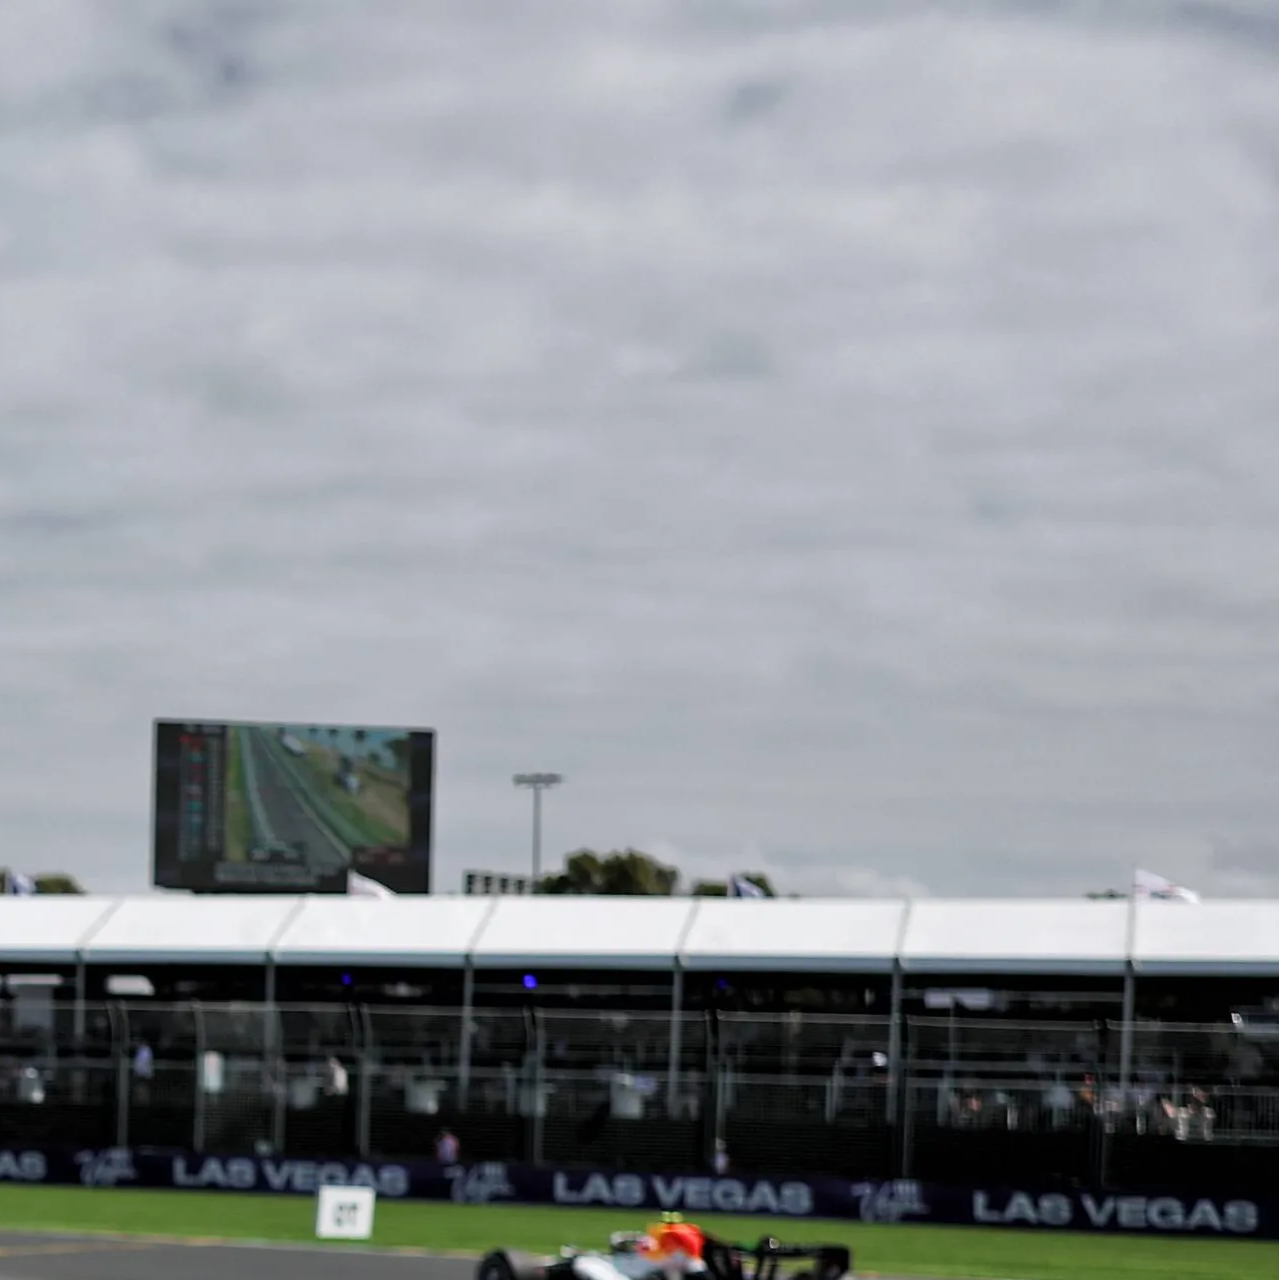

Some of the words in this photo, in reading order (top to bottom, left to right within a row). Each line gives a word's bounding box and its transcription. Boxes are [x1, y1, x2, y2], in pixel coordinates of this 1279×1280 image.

[172, 1155, 256, 1189] LAS
[261, 1159, 409, 1196] VEGAS
[553, 1172, 643, 1205] LAS
[651, 1175, 813, 1215] VEGAS
[972, 1189, 1073, 1226] LAS
[1081, 1193, 1259, 1233] VEGAS
